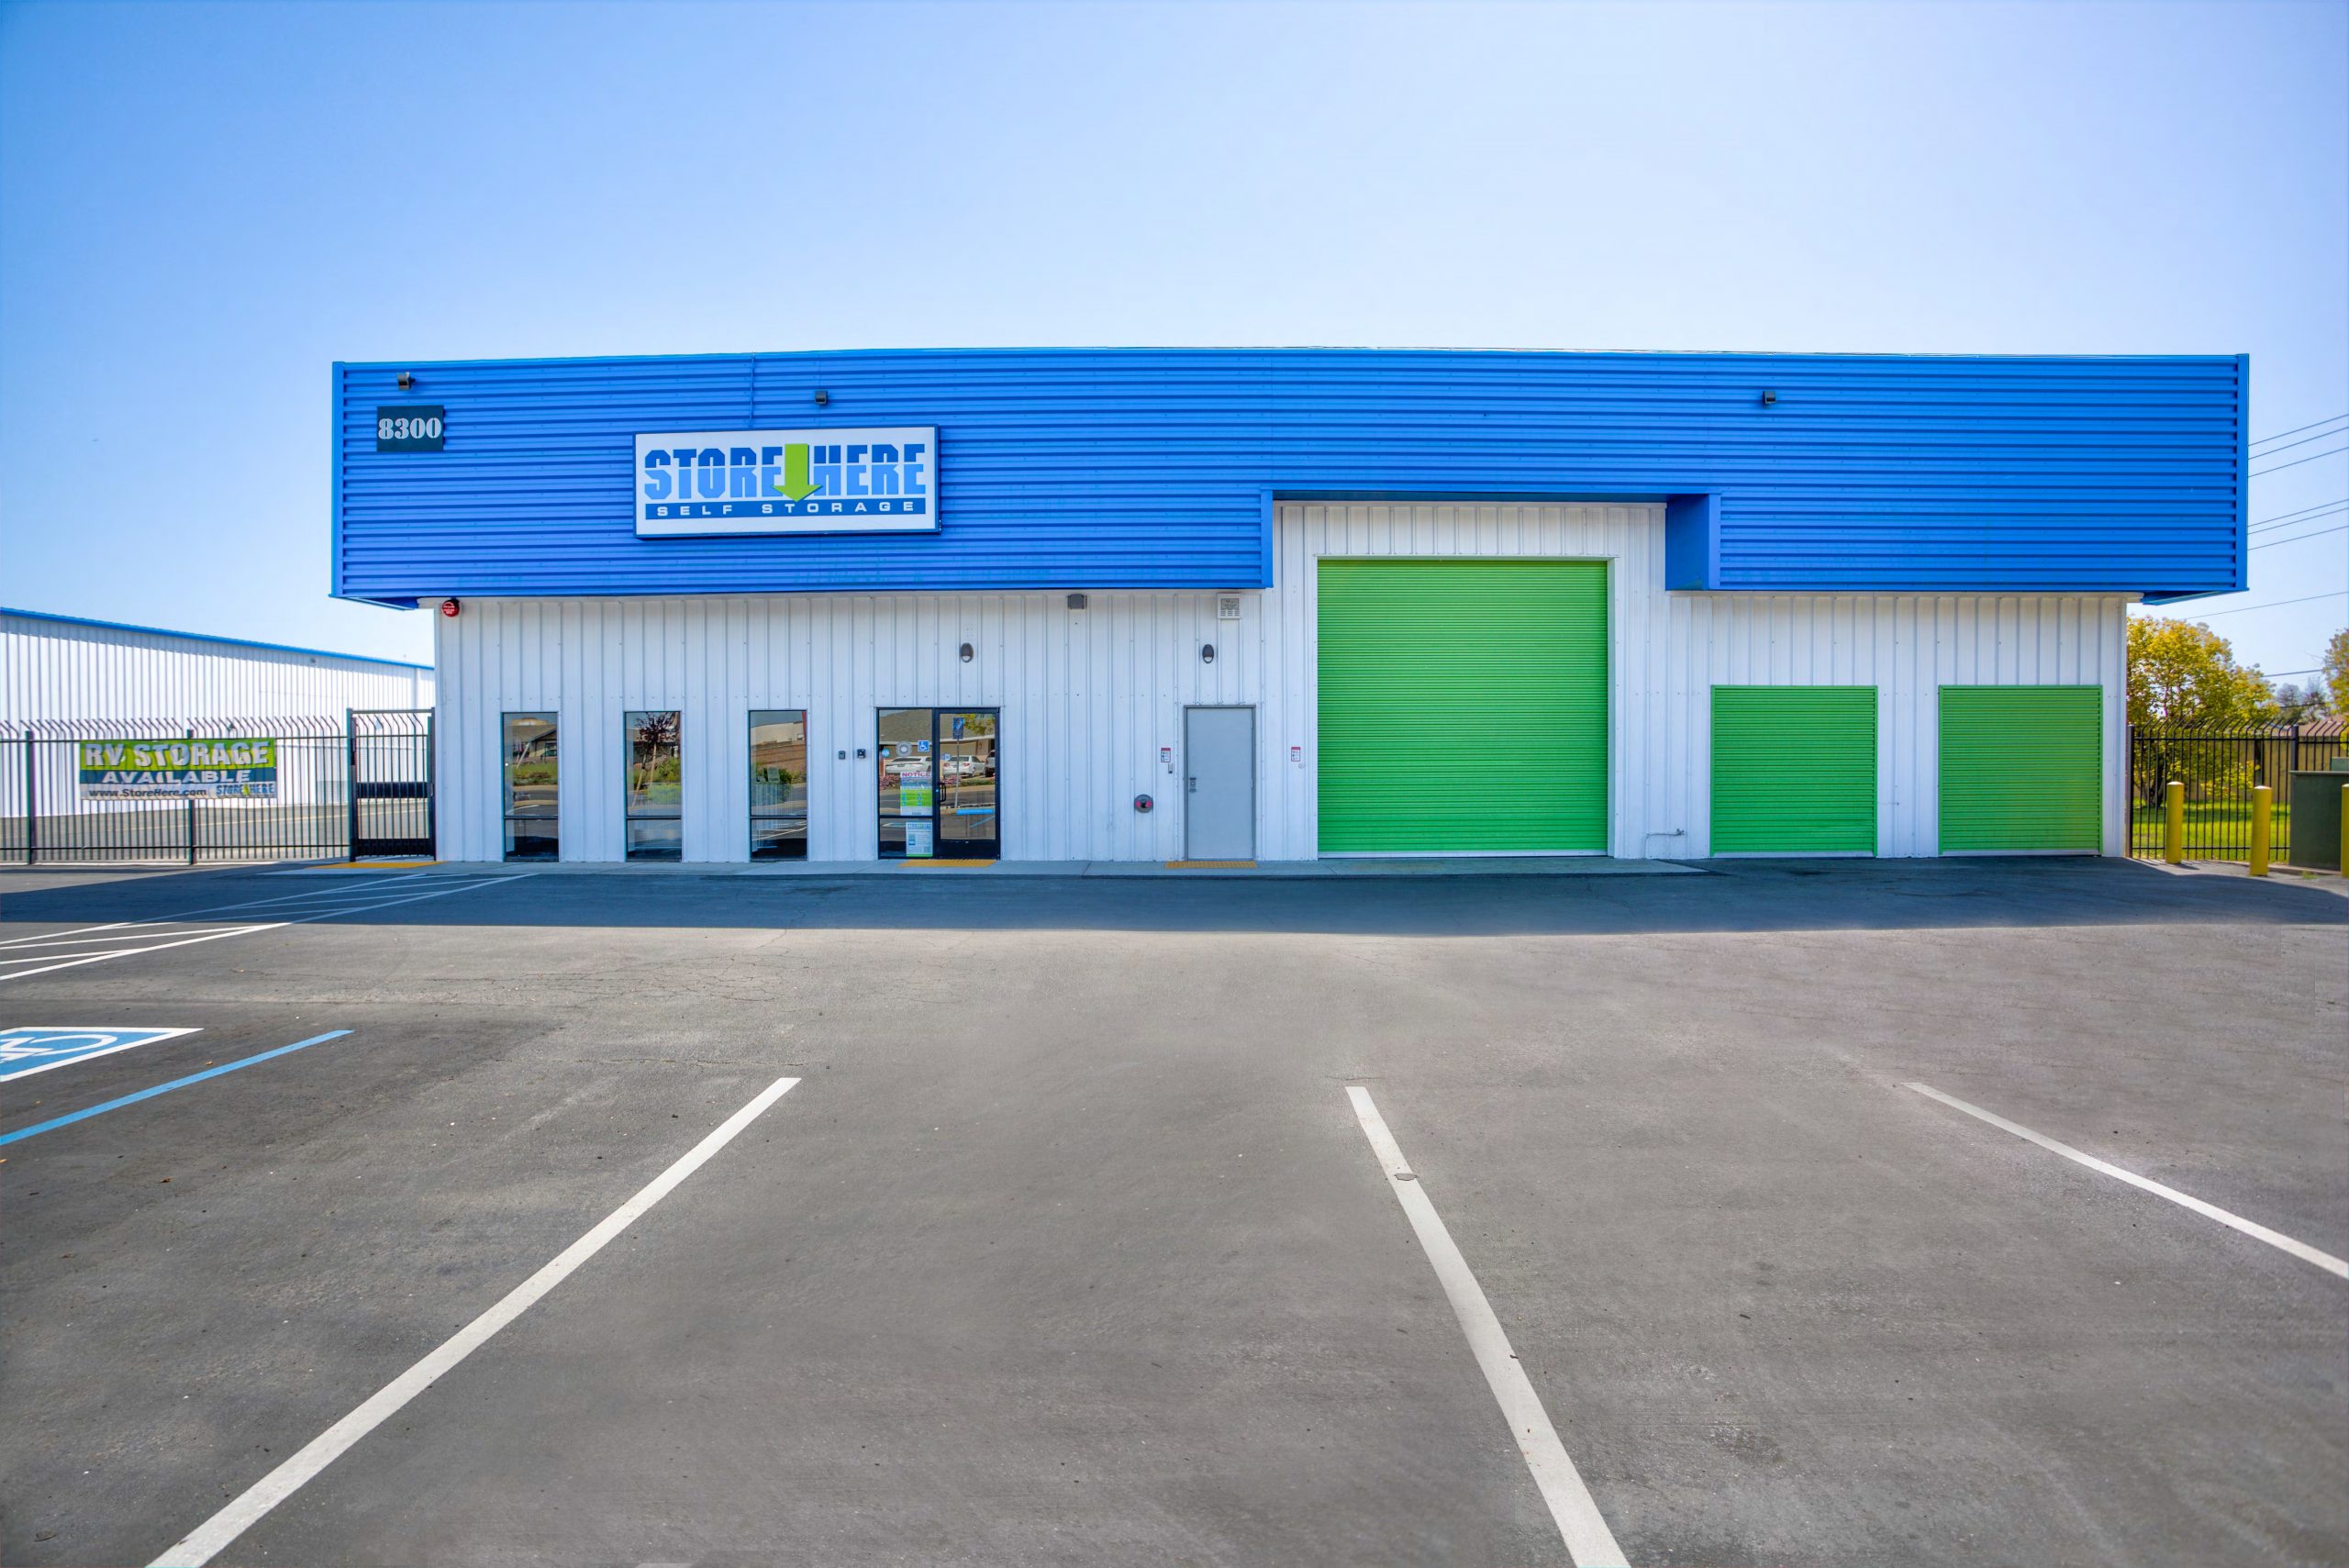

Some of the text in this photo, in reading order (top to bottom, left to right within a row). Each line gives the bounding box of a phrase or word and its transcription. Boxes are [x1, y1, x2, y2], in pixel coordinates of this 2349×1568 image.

[378, 417, 441, 439] 8300
[644, 444, 926, 499] STORE HERE
[657, 502, 914, 517] SELF STORAGE
[85, 741, 271, 767] RV STORAGE
[102, 770, 251, 784] AVAILABLE
[89, 788, 207, 797] www.StoreHere.com
[249, 783, 274, 794] HERE
